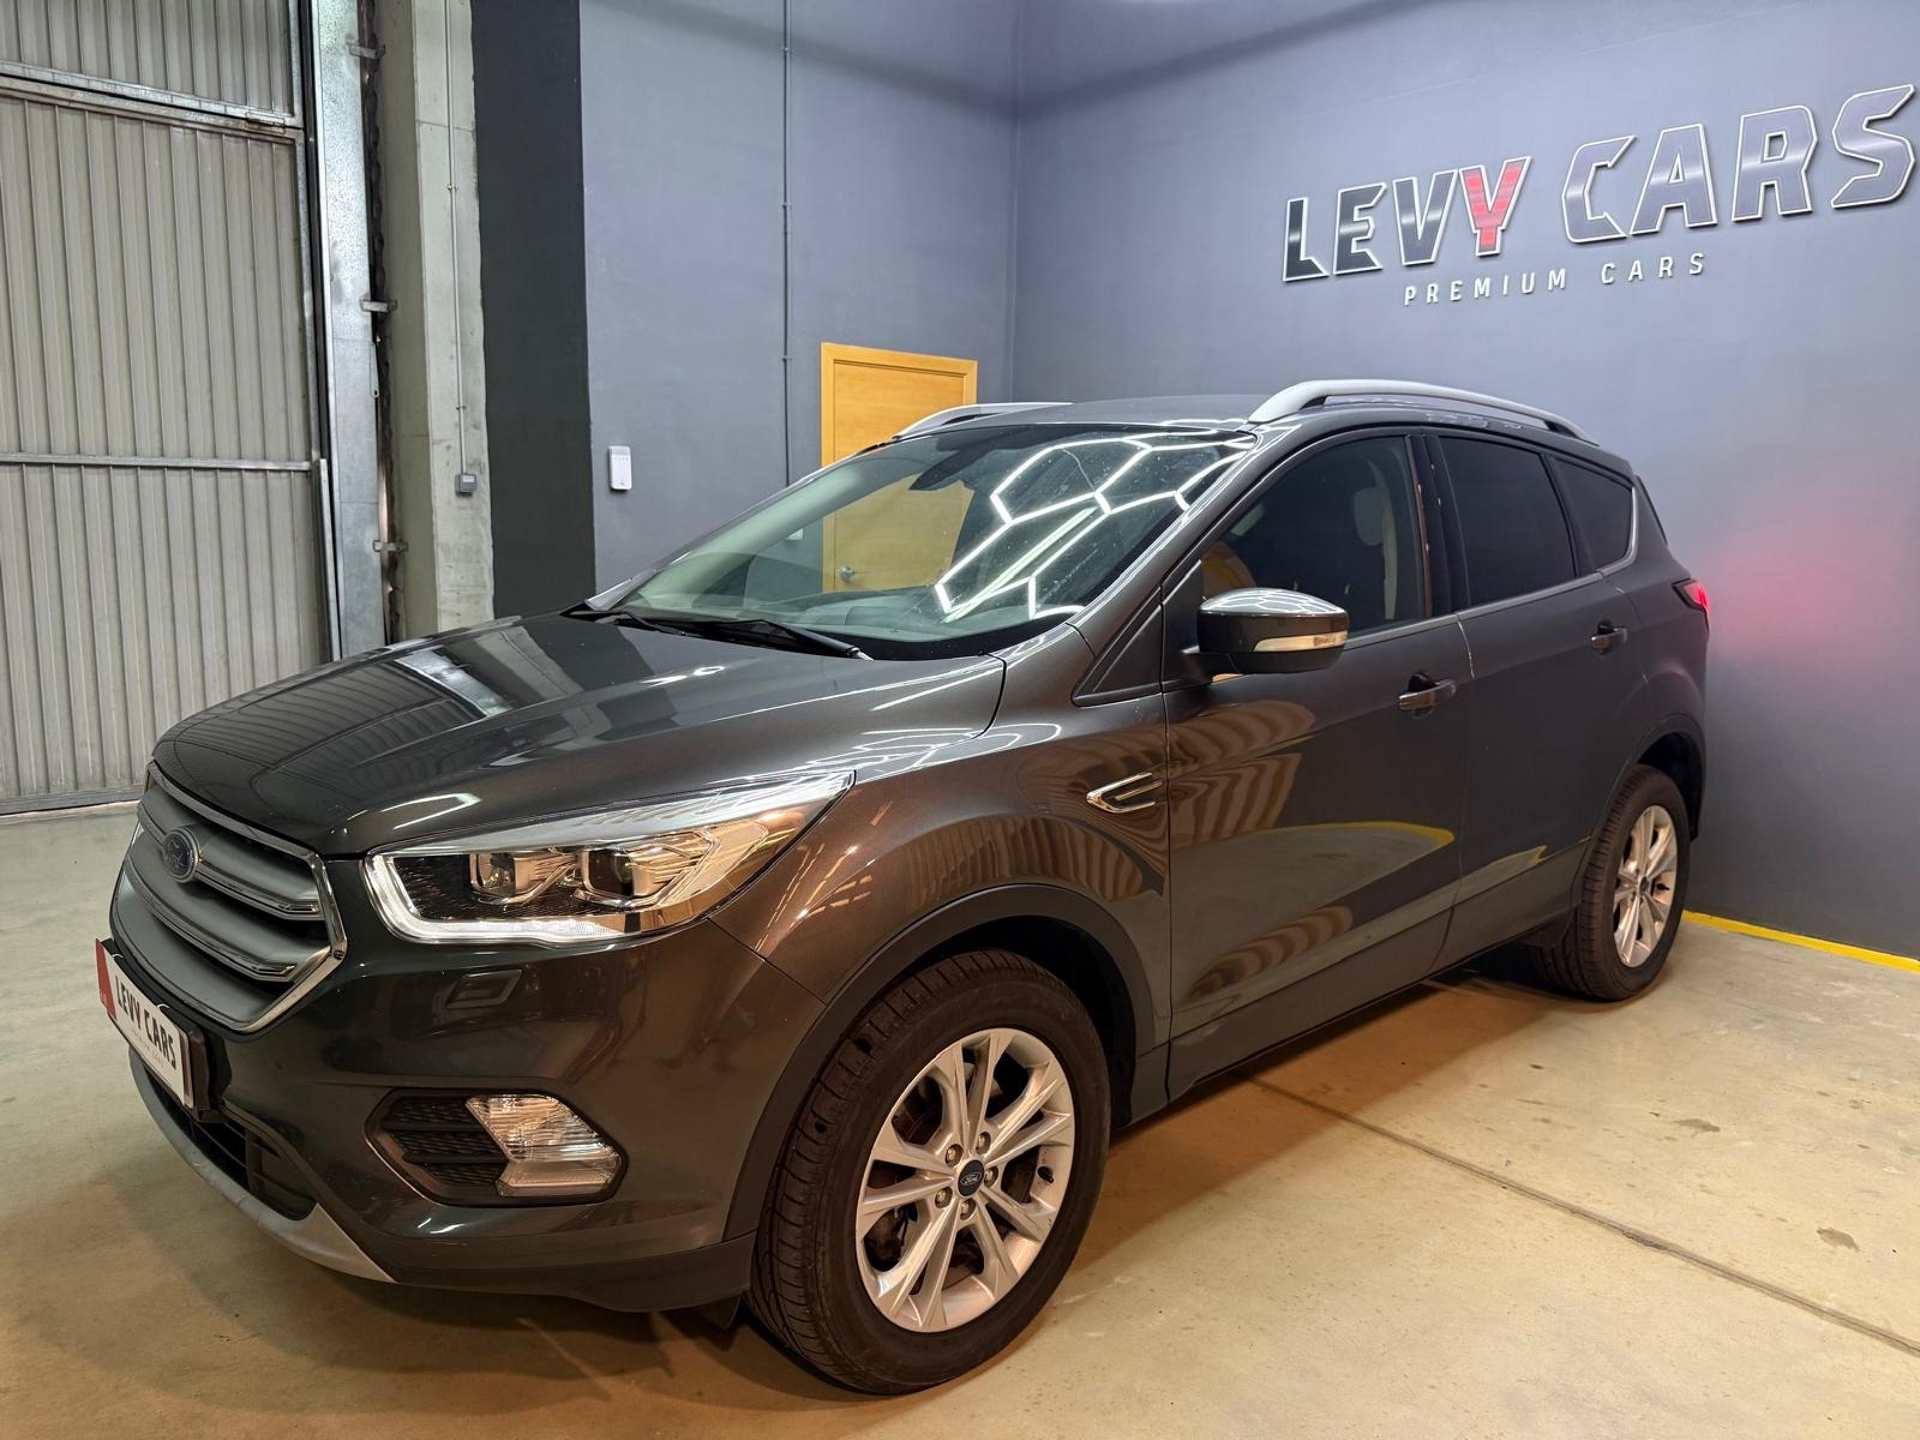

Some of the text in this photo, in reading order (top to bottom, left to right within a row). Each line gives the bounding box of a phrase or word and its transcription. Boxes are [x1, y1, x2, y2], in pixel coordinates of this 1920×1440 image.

[1283, 83, 1916, 283] LEVY CARS
[1403, 251, 1705, 306] PREMIUM CARS
[114, 974, 142, 1030] LEVY
[143, 1008, 177, 1071] CARS
